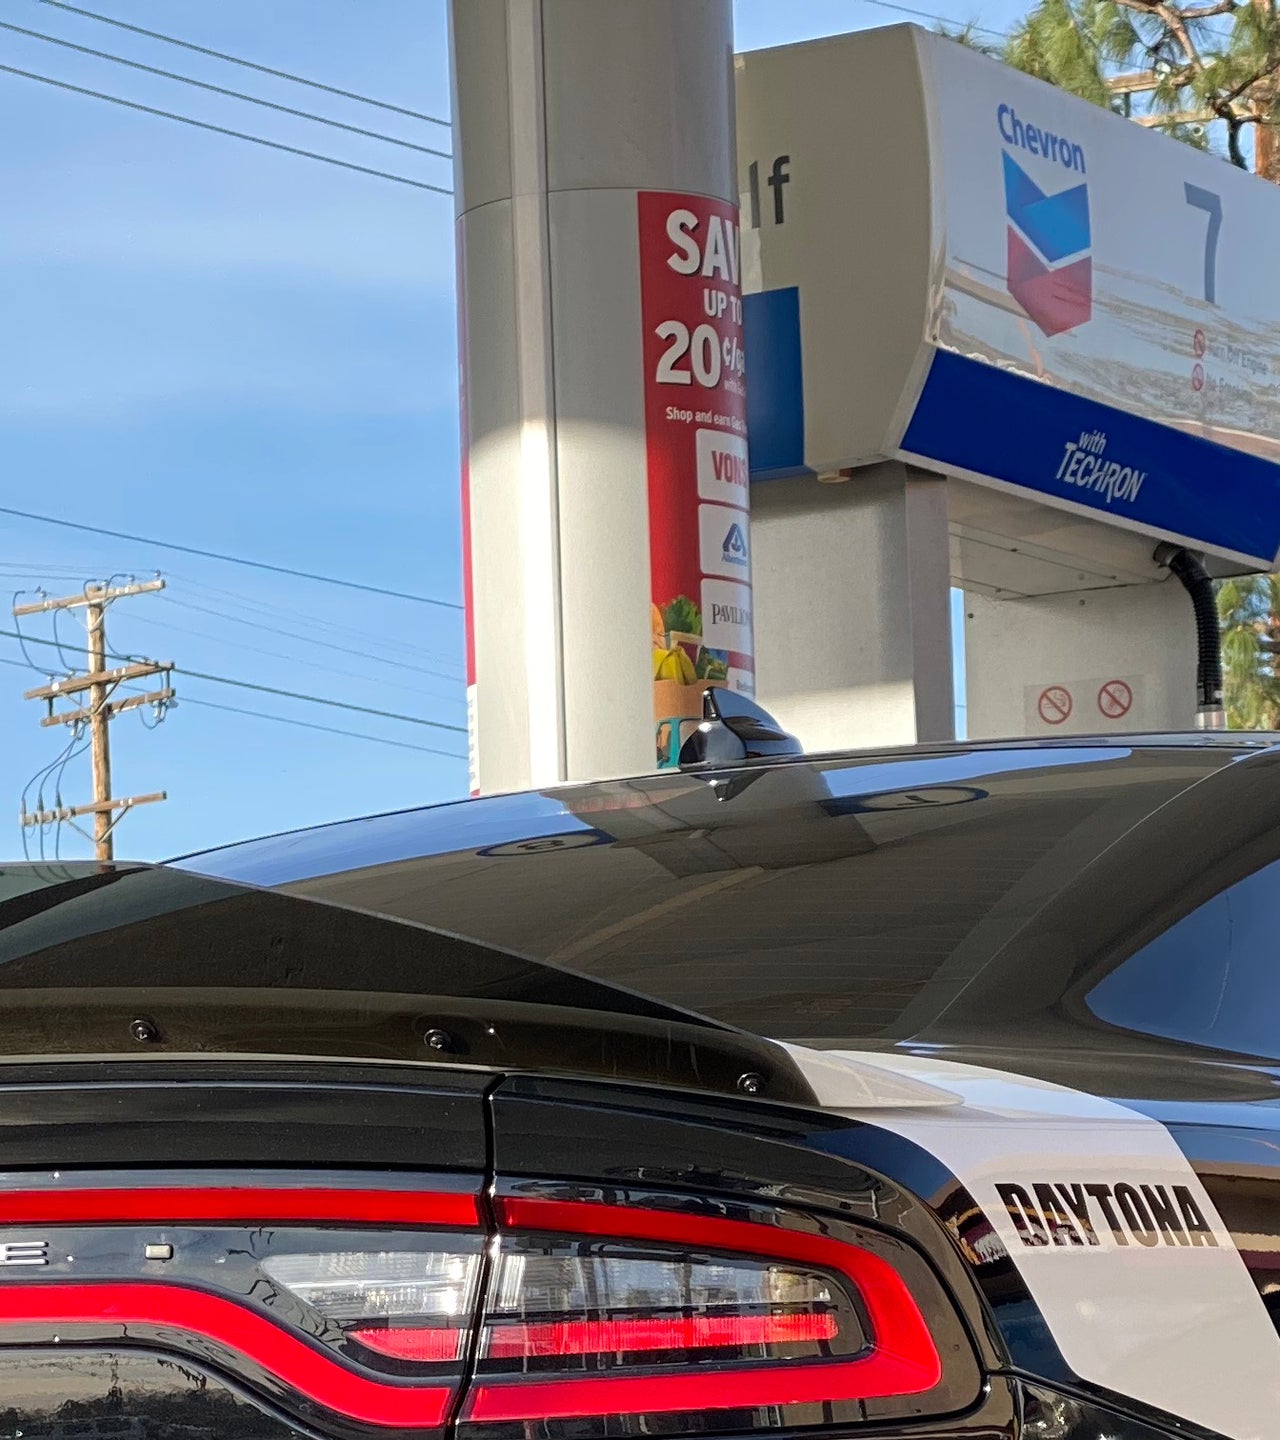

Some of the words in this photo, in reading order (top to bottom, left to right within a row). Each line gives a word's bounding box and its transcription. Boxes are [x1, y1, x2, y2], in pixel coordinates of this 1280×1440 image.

[997, 103, 1087, 174] Chevron
[749, 155, 790, 229] lf
[665, 208, 739, 285] SAV
[1183, 181, 1223, 304] 7
[703, 288, 727, 318] UP
[655, 320, 721, 388] 20
[666, 405, 693, 424] Shop
[695, 409, 712, 423] and
[1079, 429, 1106, 452] with
[711, 450, 748, 488] VONS
[1055, 441, 1147, 503] TECHRON
[993, 1181, 1220, 1248] DAYTONA
